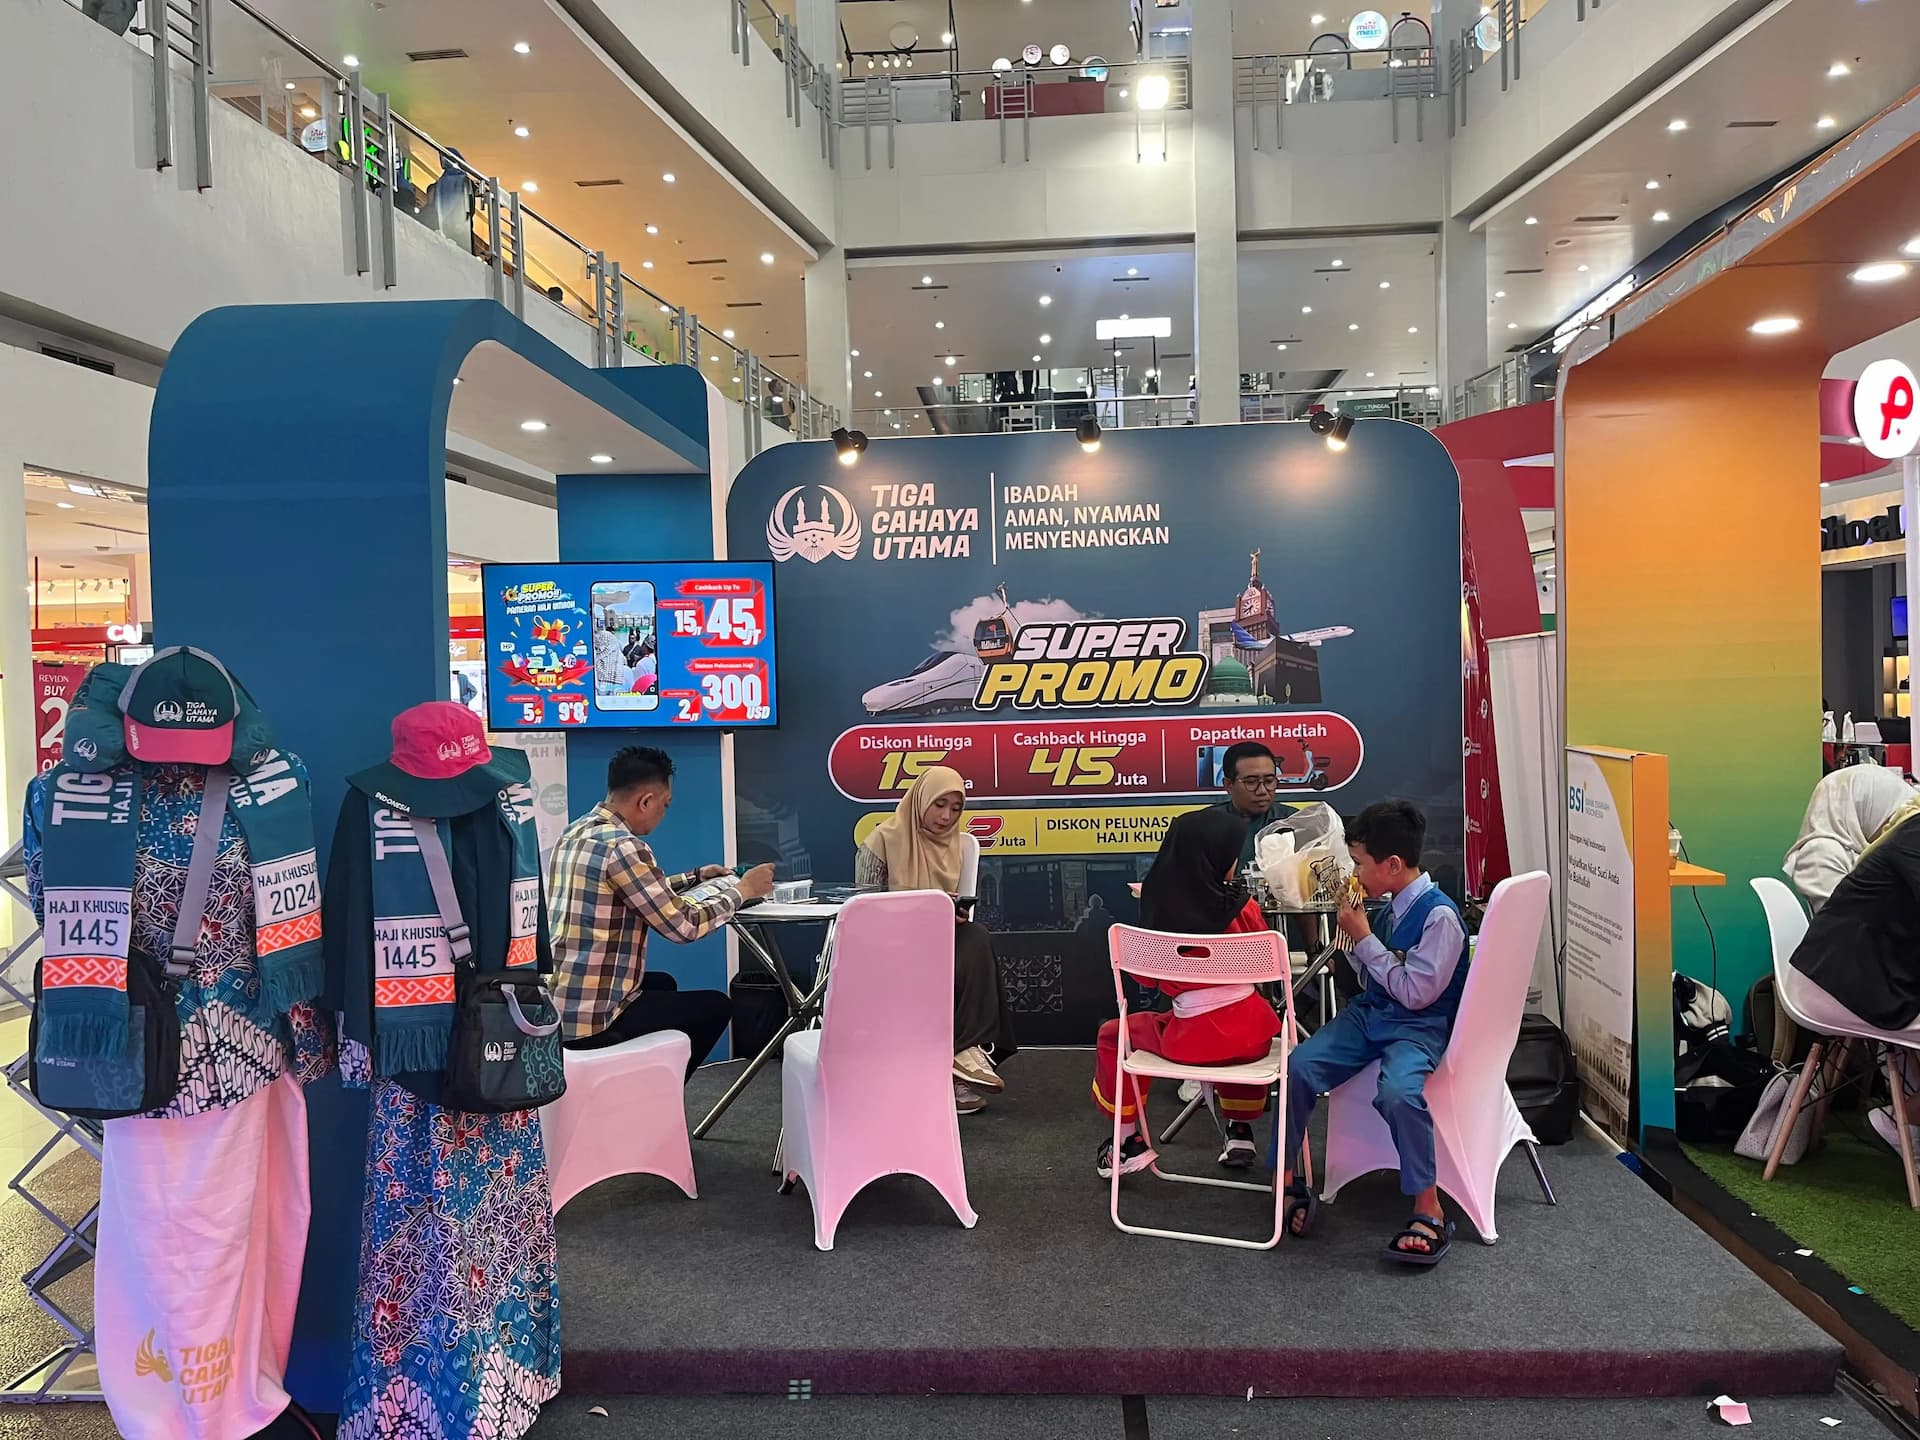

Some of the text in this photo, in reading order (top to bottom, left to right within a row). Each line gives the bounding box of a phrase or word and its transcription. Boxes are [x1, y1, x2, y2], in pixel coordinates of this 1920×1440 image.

[871, 483, 935, 508] TIGA
[1004, 484, 1078, 504] IBADAH
[871, 508, 979, 534] CAHAYA
[1005, 504, 1161, 528] AMAN, NYAMAN
[873, 534, 969, 560] UTAMA
[1005, 526, 1169, 550] MENYENANGKAN
[522, 583, 554, 593] SUPER
[674, 610, 697, 633] 15
[707, 599, 757, 640] 45
[1014, 623, 1181, 660] SUPER
[39, 674, 69, 683] REVLON
[44, 686, 65, 696] BUY
[979, 658, 1203, 705] PROMO
[678, 699, 691, 719] 2
[702, 674, 771, 719] 300 USD
[40, 697, 69, 749] 2
[524, 703, 535, 721] 5
[860, 735, 972, 750] Diskon Hingga
[1013, 730, 1146, 746] Cashback Hingga
[1190, 724, 1327, 743] Dapatkan Hadiah
[42, 758, 64, 773] ON
[531, 747, 549, 758] AH
[246, 748, 298, 807] MA
[878, 751, 949, 791] 15
[1028, 746, 1148, 787] 45 Juta
[51, 772, 113, 826] TIG
[110, 781, 133, 824] HAJI
[228, 776, 253, 809] OUR
[374, 791, 411, 813] INDONESIA
[506, 783, 535, 825] MA
[1569, 785, 1584, 813] BSI
[497, 789, 517, 823] OUR
[373, 808, 420, 860] TIG
[966, 816, 1026, 850] 2 Juta
[1047, 818, 1100, 830] DISKON
[1097, 831, 1167, 843] HAJI KHU
[257, 872, 281, 888] HAJI
[49, 900, 130, 915] HAJI KHUSUS
[270, 879, 317, 916] 2024
[59, 919, 119, 946] 1445
[374, 926, 446, 942] HAJI KHUSUS
[383, 944, 437, 970] 1445
[180, 1336, 230, 1365] TIGA
[180, 1354, 234, 1386] CAH
[183, 1377, 229, 1405] UTA
